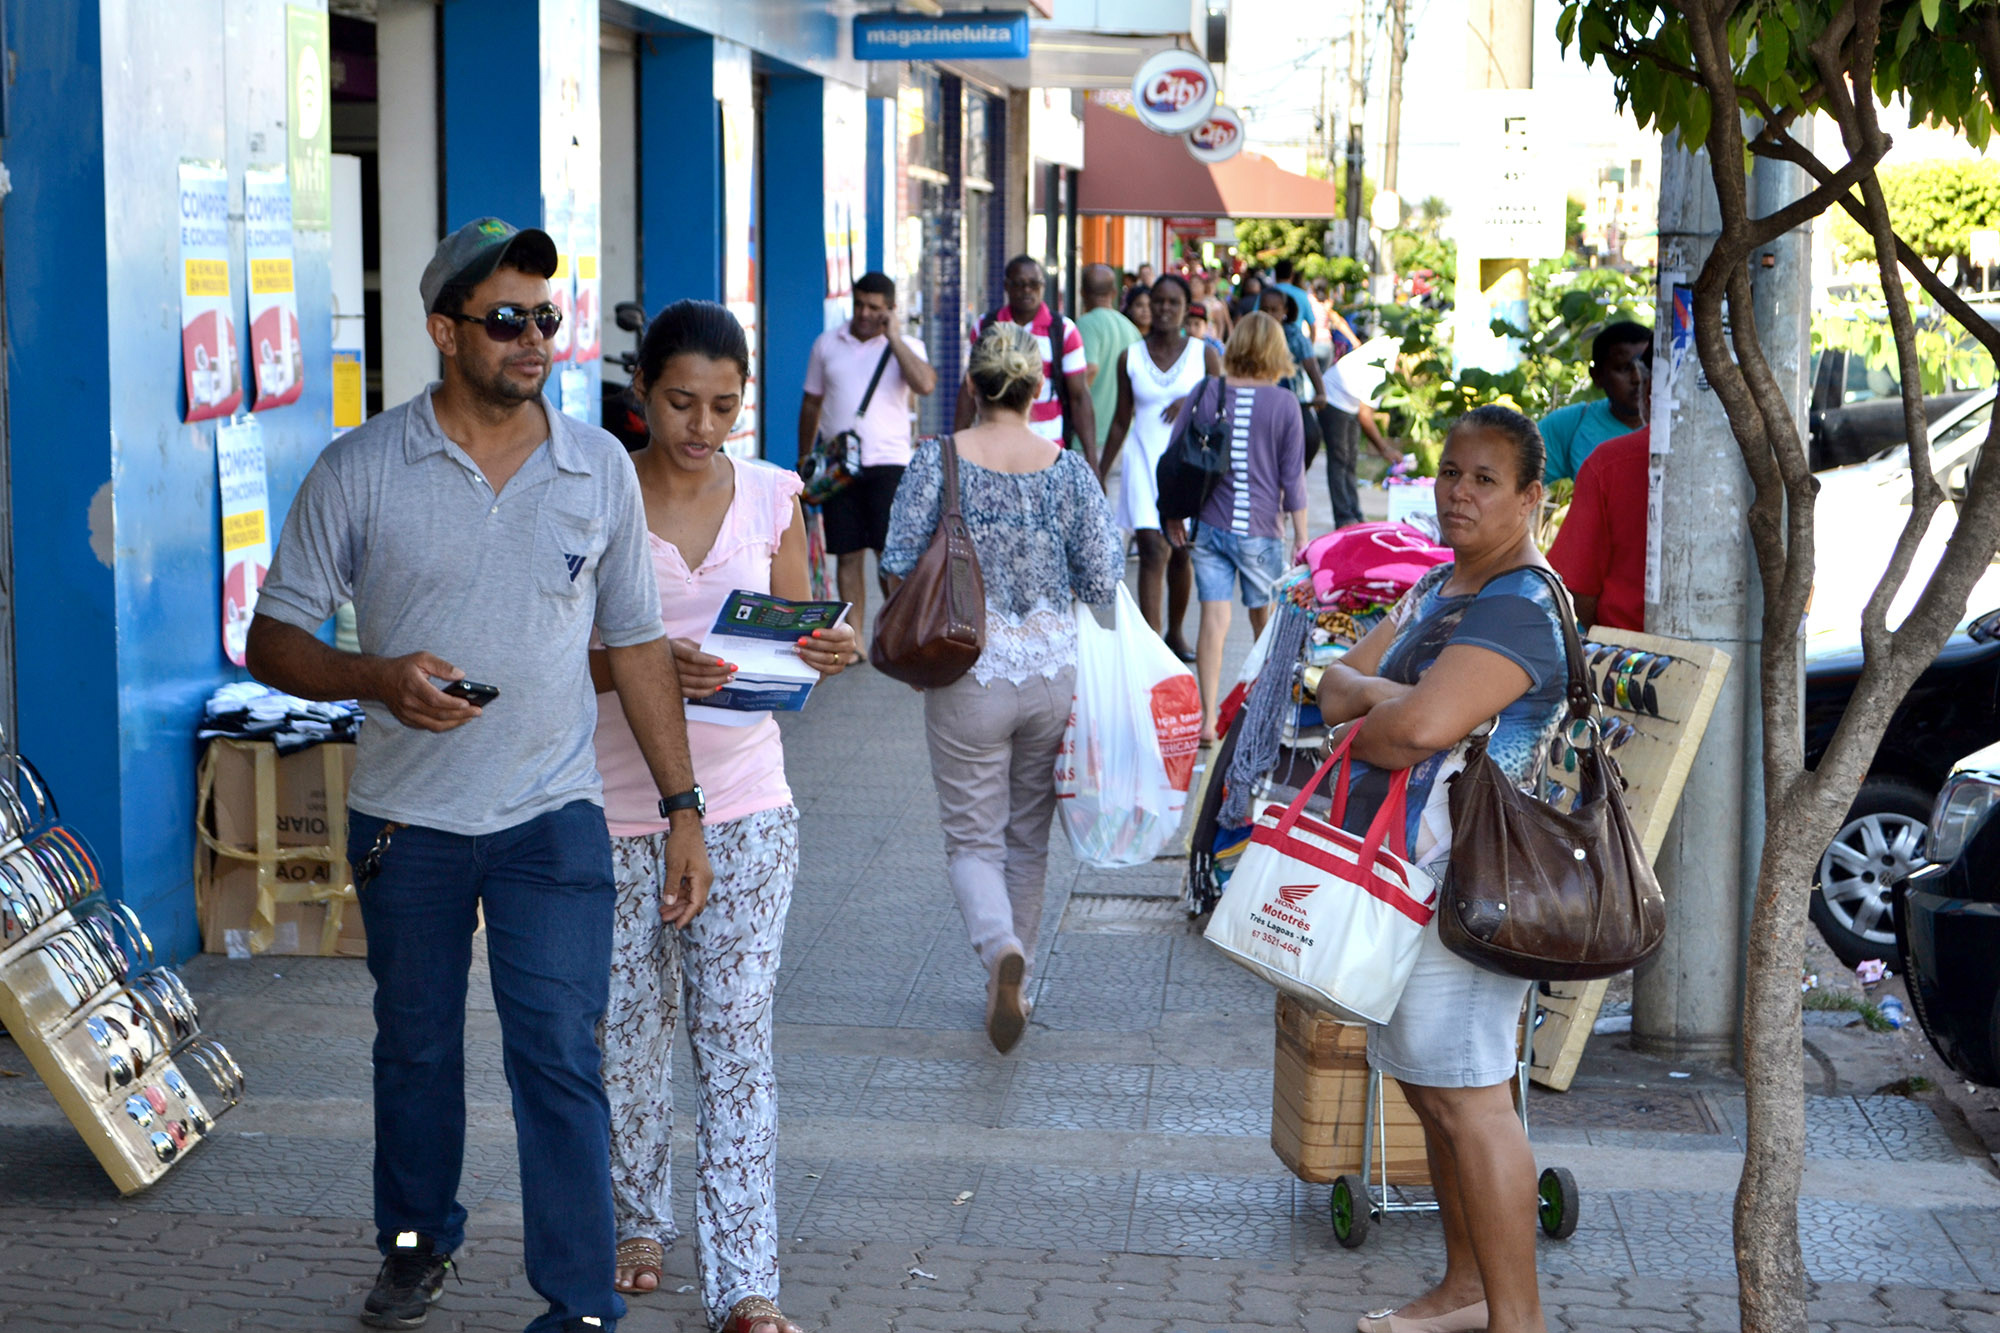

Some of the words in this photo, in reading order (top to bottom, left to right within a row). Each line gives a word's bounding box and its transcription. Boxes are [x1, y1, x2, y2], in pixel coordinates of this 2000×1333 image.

[867, 25, 1011, 47] magazineluiza
[1146, 73, 1205, 111] City
[1193, 121, 1236, 149] City
[219, 446, 264, 477] COMPRE
[277, 815, 329, 834] OIAR
[1261, 903, 1311, 931] Mototrês
[1274, 897, 1308, 916] HONDA
[1250, 912, 1265, 925] Três
[1266, 920, 1294, 938] Lagoas
[1301, 935, 1314, 947] MS
[1252, 929, 1261, 938] 67
[1262, 932, 1302, 957] 3521-4642
